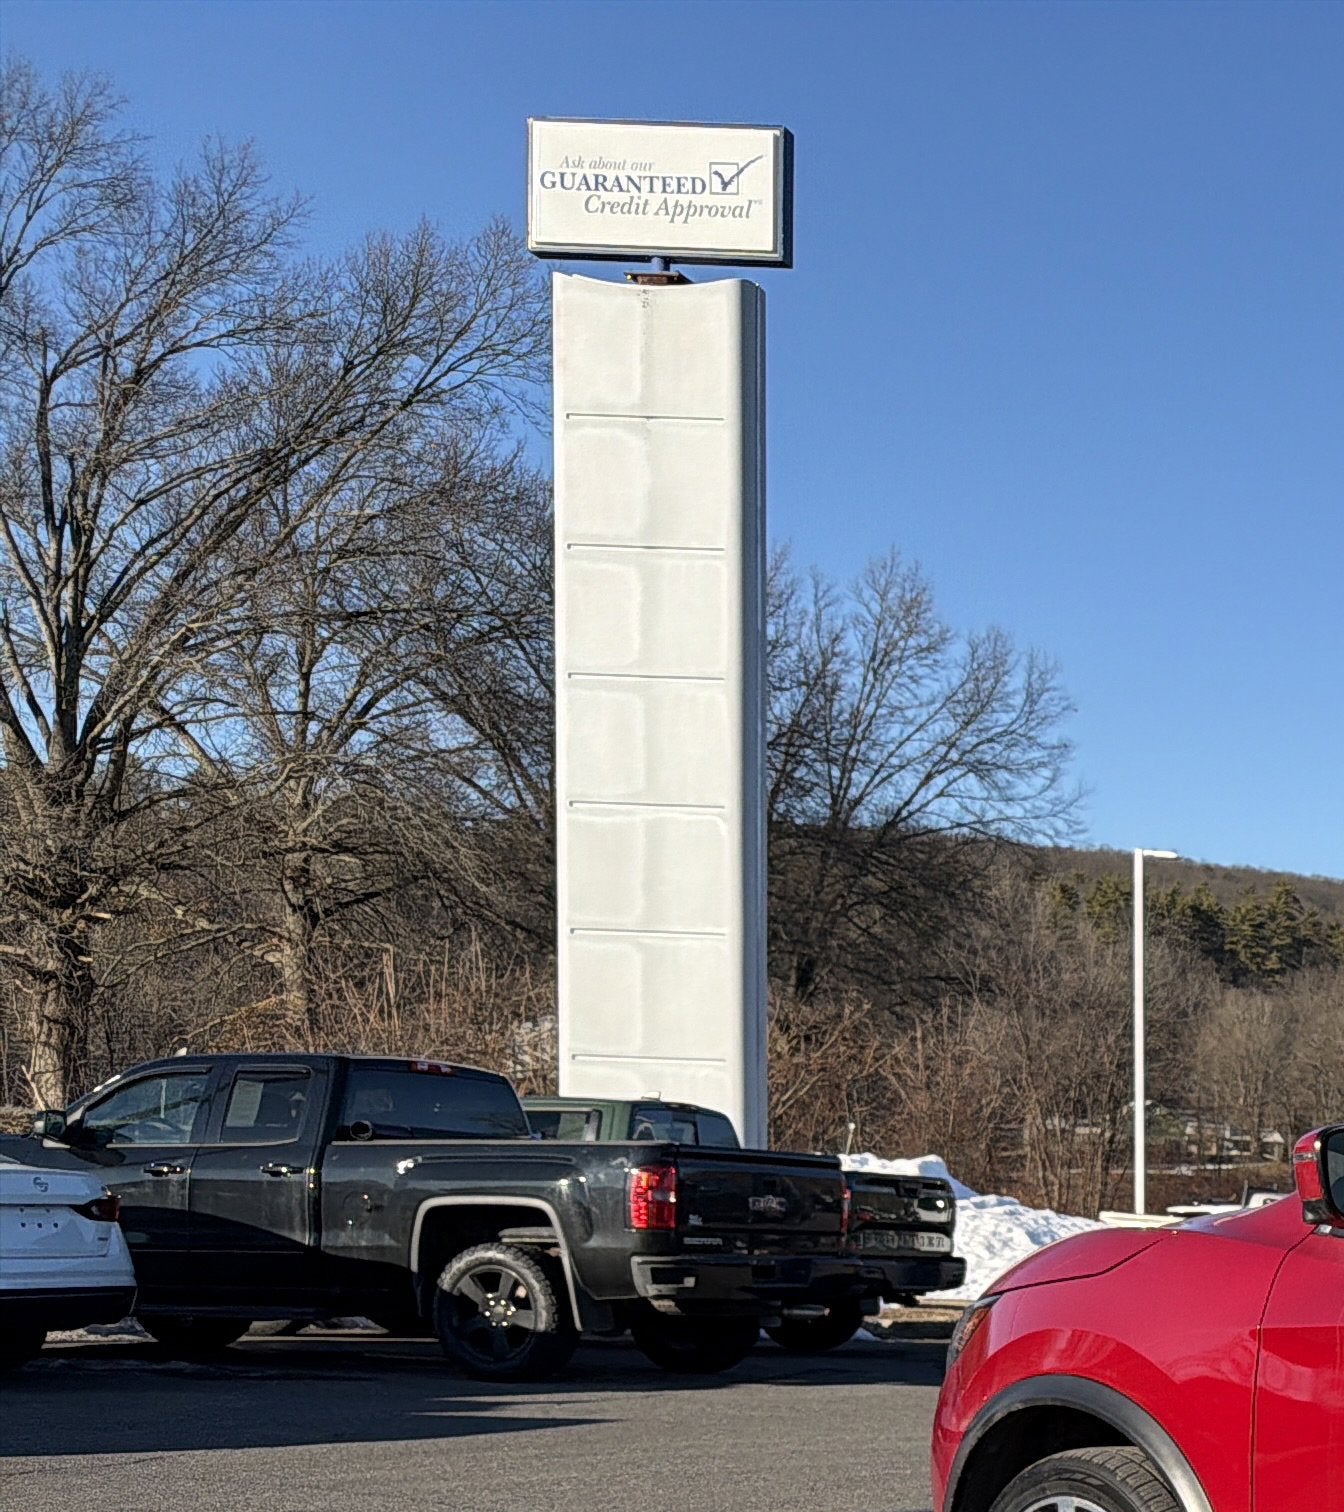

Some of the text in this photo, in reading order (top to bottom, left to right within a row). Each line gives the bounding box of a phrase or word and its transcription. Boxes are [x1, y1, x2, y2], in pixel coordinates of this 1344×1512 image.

[559, 155, 655, 171] Ask about our
[539, 170, 707, 195] GUARANTEED
[584, 194, 753, 224] Credit Approval
